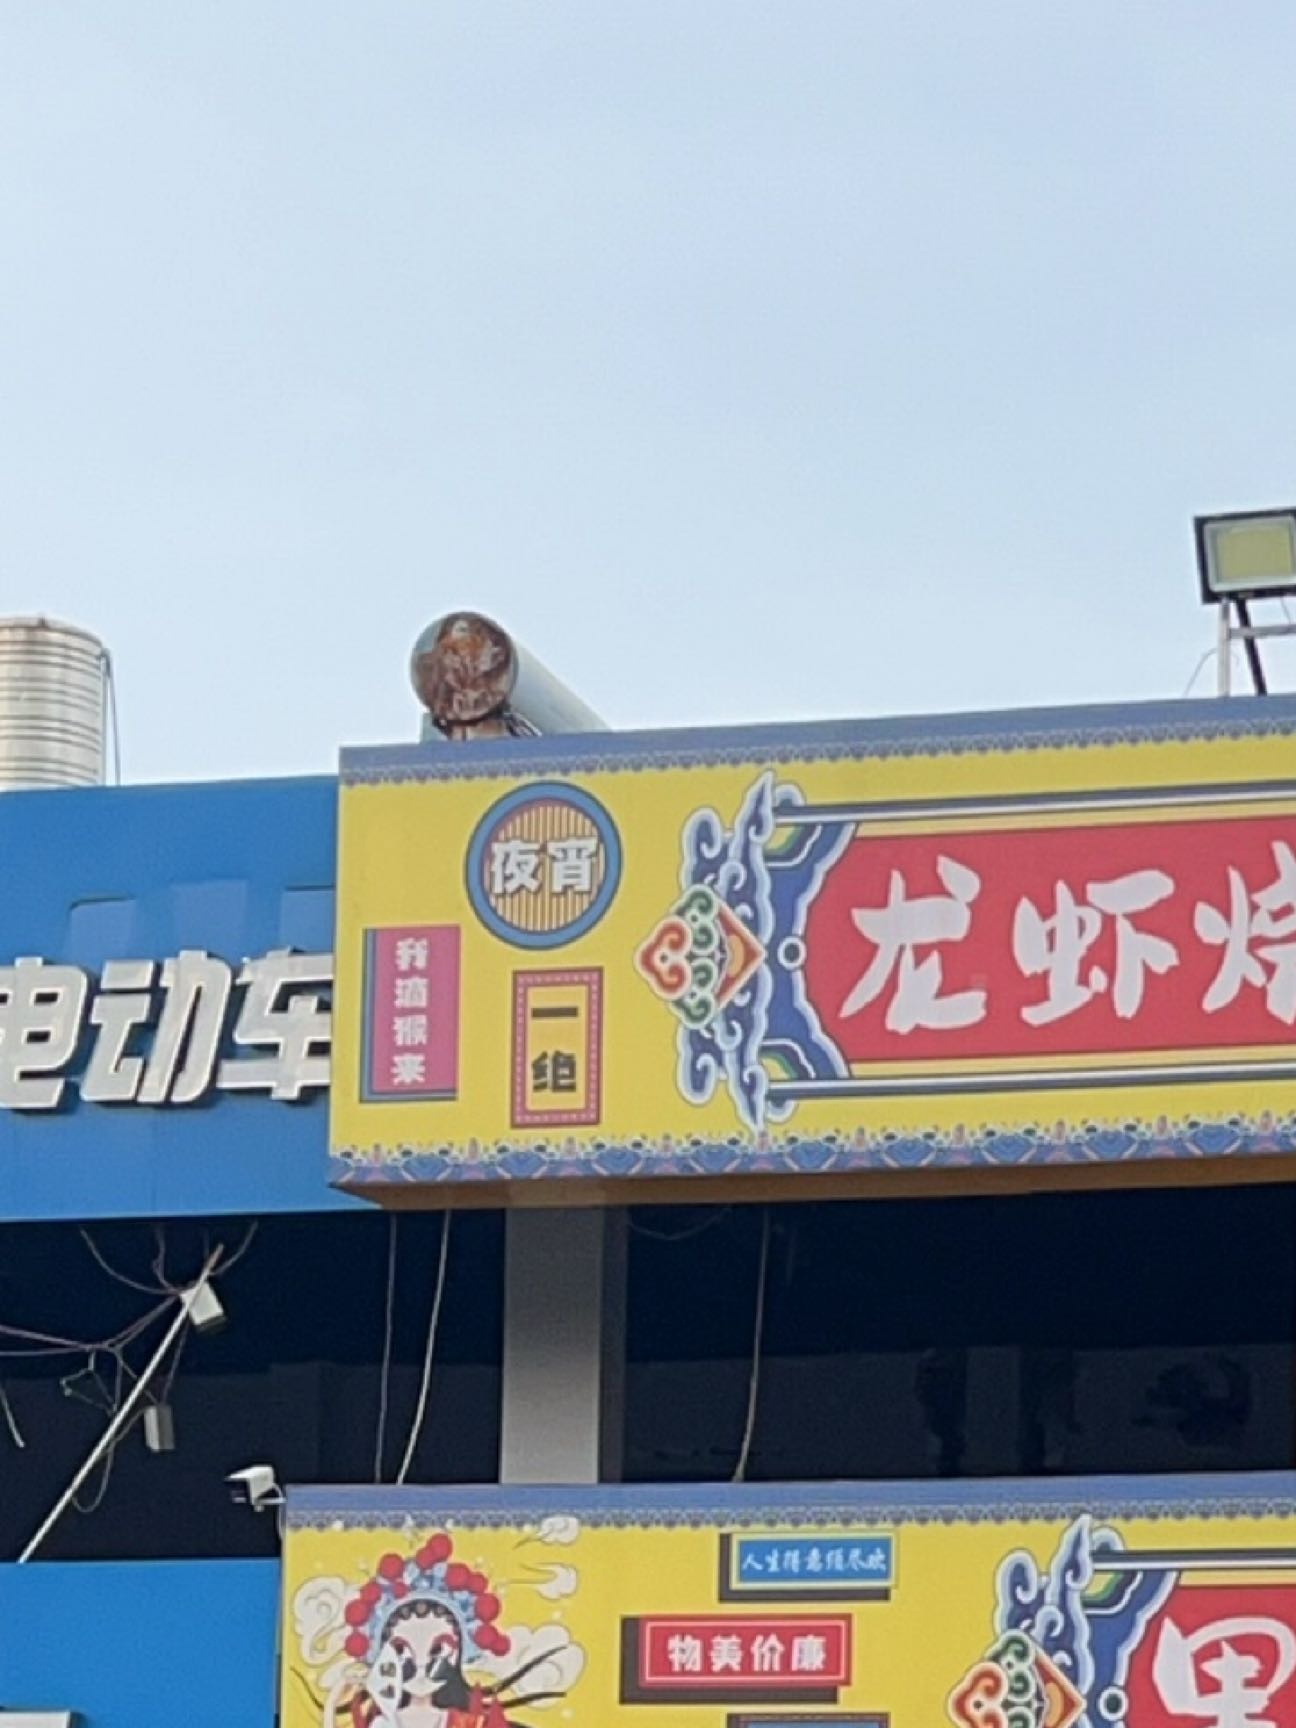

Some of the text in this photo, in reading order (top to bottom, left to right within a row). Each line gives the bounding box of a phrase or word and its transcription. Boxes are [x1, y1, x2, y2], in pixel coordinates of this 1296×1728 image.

[491, 837, 599, 895] 夜宵
[0, 945, 334, 1108] 电动车
[531, 1005, 580, 1093] 一绝
[666, 1634, 827, 1673] 物美价廉
